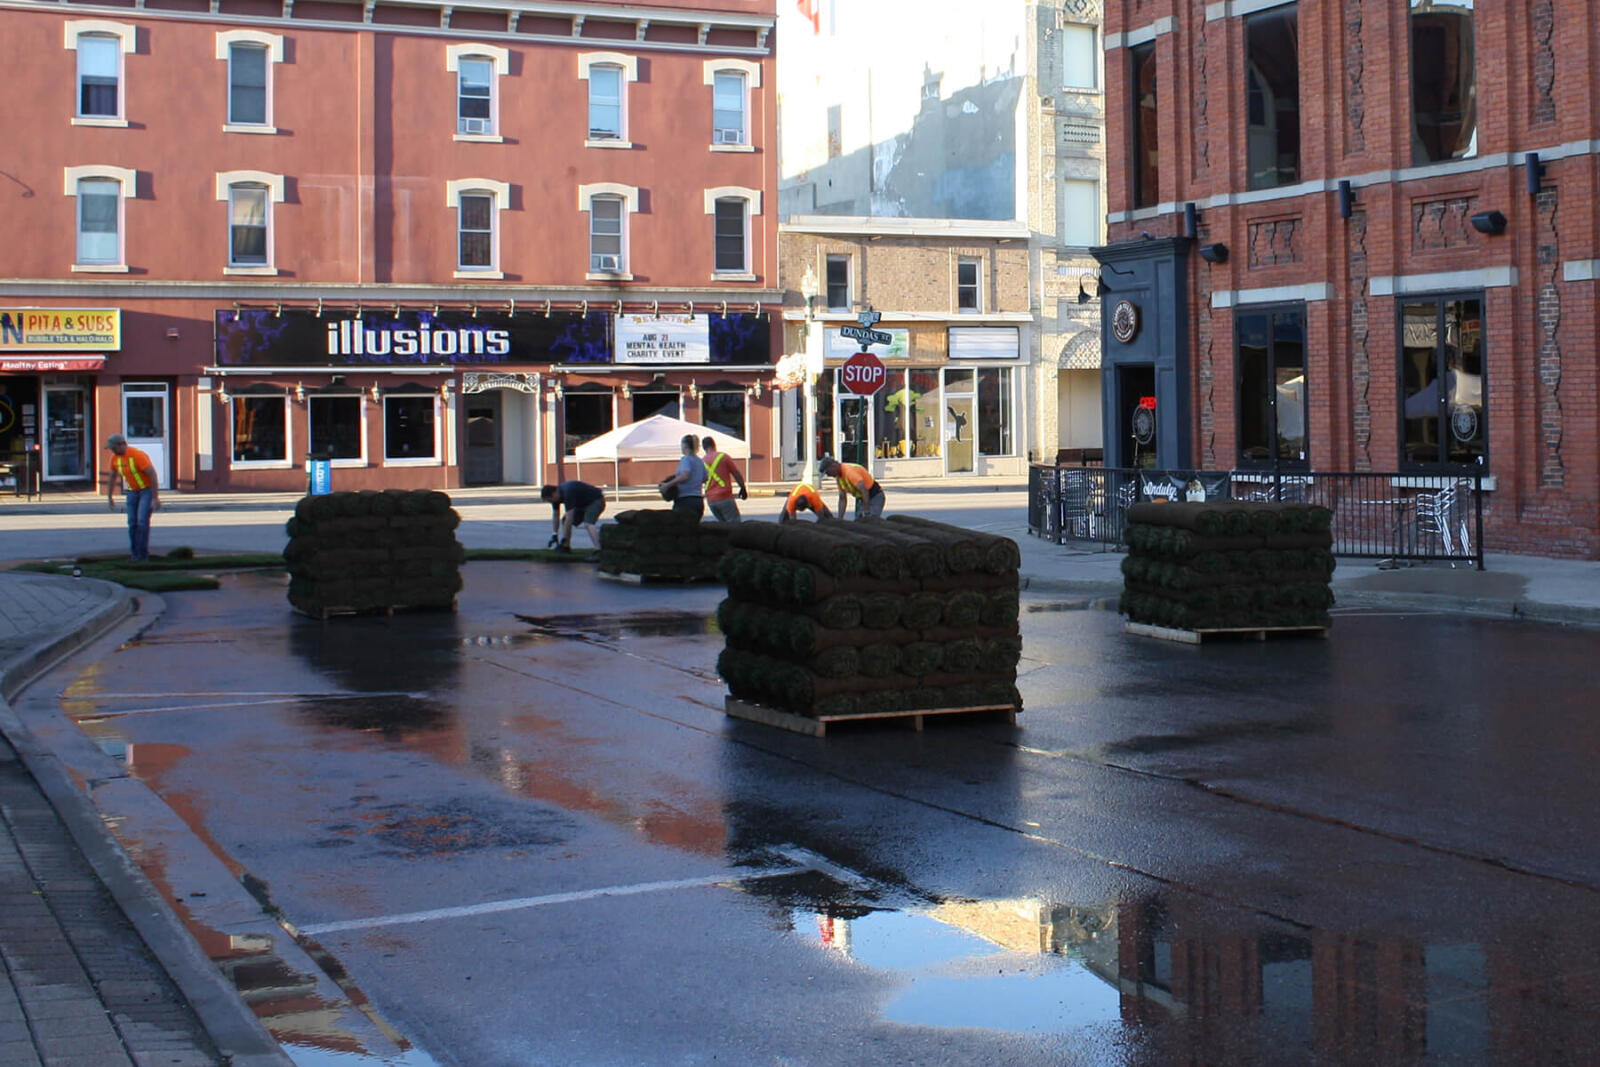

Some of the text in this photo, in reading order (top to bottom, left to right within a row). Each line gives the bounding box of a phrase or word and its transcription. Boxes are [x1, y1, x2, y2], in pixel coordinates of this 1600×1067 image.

[29, 315, 113, 331] PITA & SUBS
[56, 335, 68, 343] TEA
[327, 319, 511, 355] illusions
[643, 333, 657, 342] AUG
[843, 326, 879, 341] DUNDAS
[626, 342, 686, 350] MENTAL HEALTH
[627, 350, 685, 358] CHARITY EVENT
[845, 365, 882, 383] STOP
